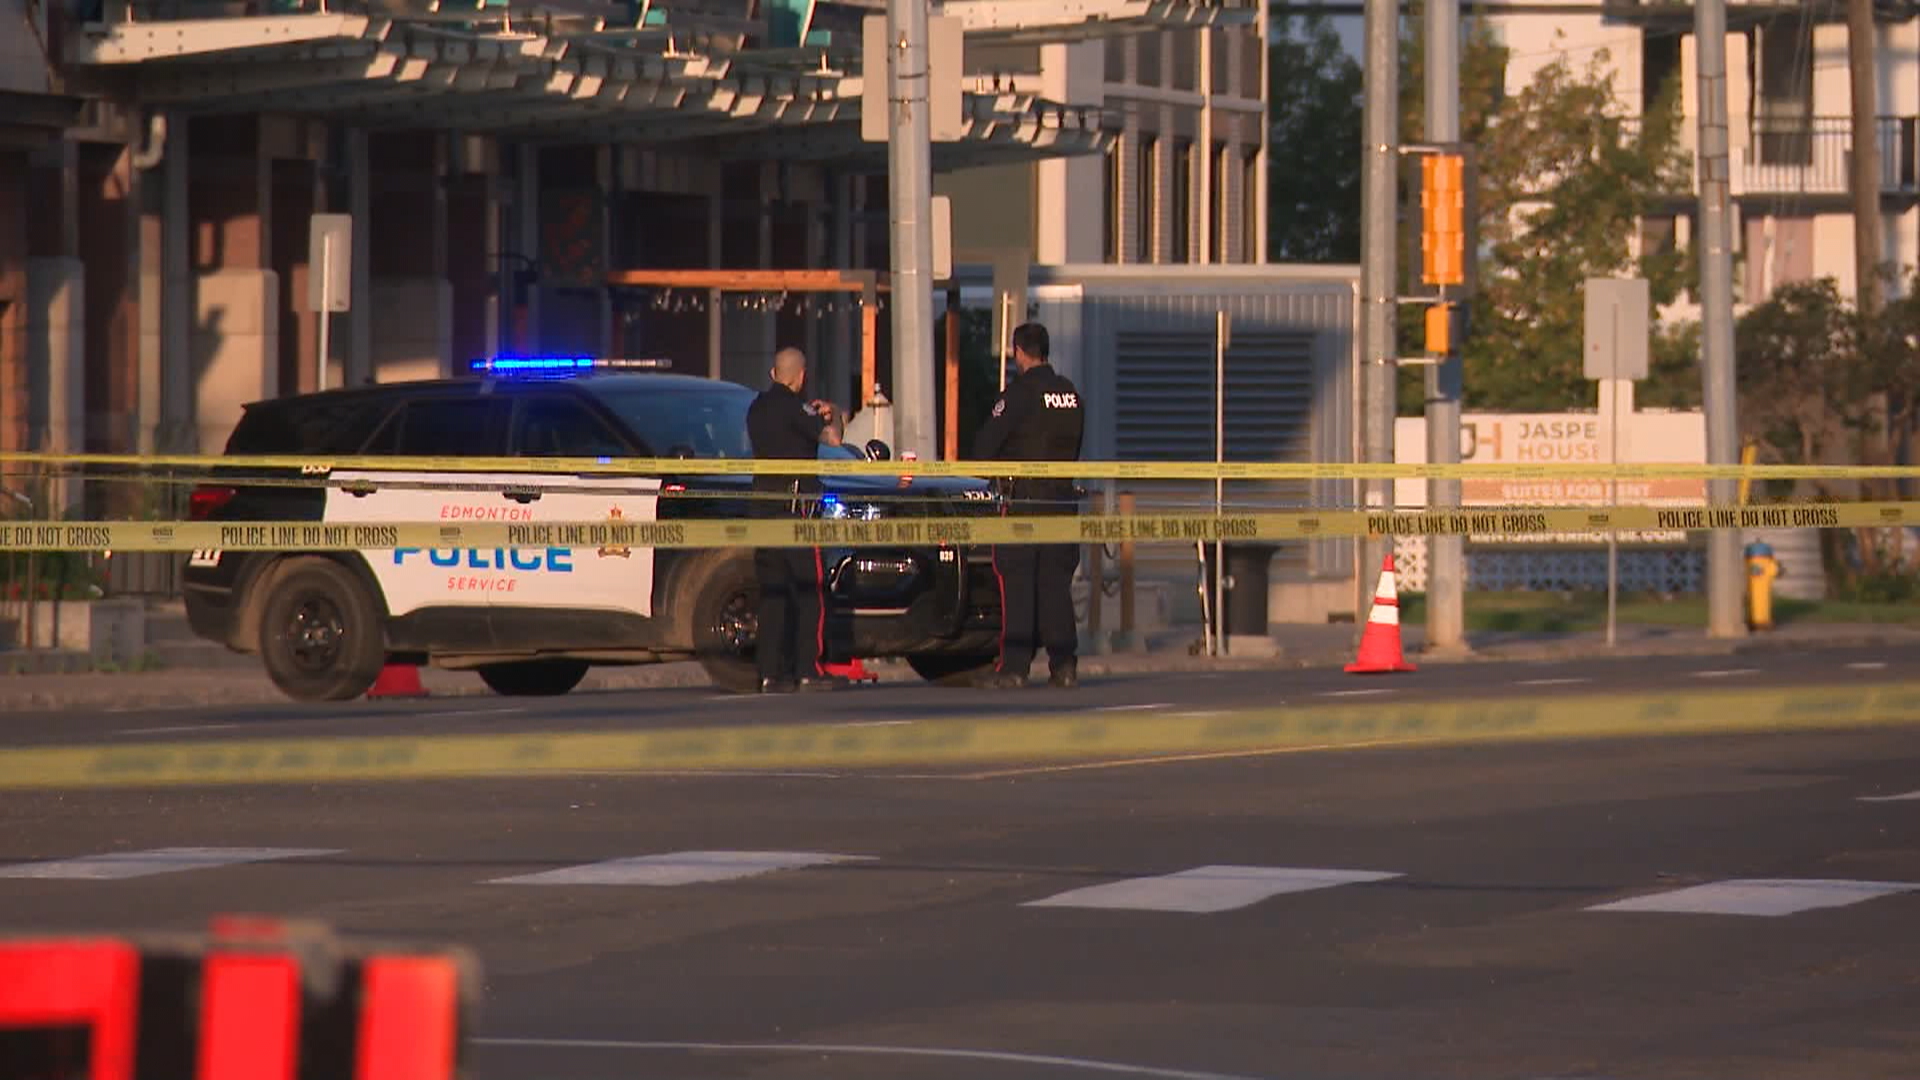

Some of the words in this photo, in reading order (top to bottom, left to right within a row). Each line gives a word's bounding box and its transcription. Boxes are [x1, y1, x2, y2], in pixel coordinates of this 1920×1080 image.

[1043, 392, 1078, 409] POLICE
[1518, 422, 1597, 439] JASPE
[440, 505, 533, 521] EDMONTON
[1658, 510, 1704, 528] POLICE
[1709, 509, 1737, 527] LINE
[1741, 509, 1759, 527] DO
[1763, 508, 1789, 527] NOT
[1792, 507, 1839, 526] CROSS
[508, 525, 553, 544] POLICE
[558, 525, 585, 544] LINE
[590, 525, 608, 544] DO
[611, 525, 637, 543] NOT
[641, 524, 684, 543] CROSS
[794, 523, 839, 542] POLICE
[845, 523, 872, 542] LINE
[876, 523, 893, 542] DO
[897, 523, 921, 542] NOT
[928, 522, 970, 541] CROSS
[1080, 520, 1125, 538] POLICE
[1130, 520, 1160, 538] LINE
[1162, 519, 1179, 537] DO
[1183, 519, 1208, 537] NOT
[1213, 518, 1257, 537] CROSS
[1368, 516, 1417, 535] POLICE
[1418, 515, 1447, 534] LINE
[1450, 515, 1468, 533] DO
[1471, 514, 1497, 533] NOT
[1502, 513, 1546, 532] CROSS
[16, 527, 32, 546] DO
[37, 526, 63, 546] NOT
[67, 526, 110, 546] CROSS
[221, 526, 266, 546] POLICE
[271, 526, 299, 546] LINE
[303, 526, 320, 546] DO
[324, 526, 351, 546] NOT
[354, 526, 397, 546] CROSS
[447, 577, 517, 592] SERVICE
